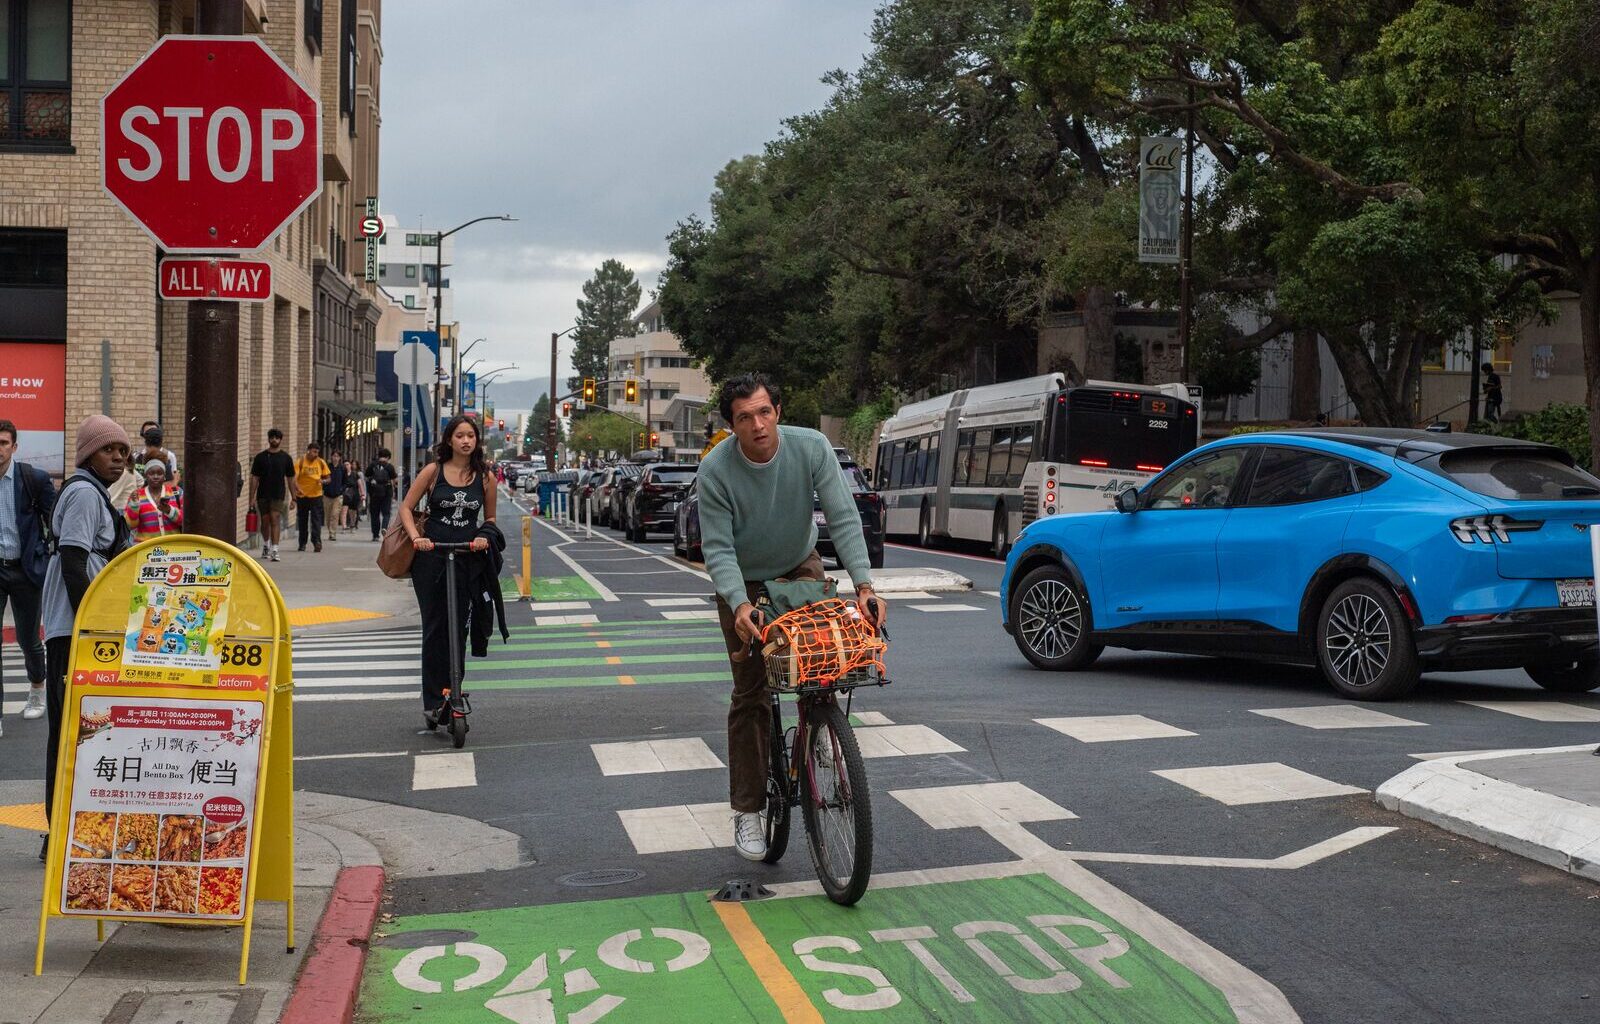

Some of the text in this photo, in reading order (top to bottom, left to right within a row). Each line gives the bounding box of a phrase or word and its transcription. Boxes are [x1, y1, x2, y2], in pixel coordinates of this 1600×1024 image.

[118, 105, 305, 183] STOP
[1145, 143, 1179, 168] Cal
[168, 267, 263, 293] ALL WAY
[1, 378, 44, 388] E NOW
[1151, 400, 1167, 413] 52
[1148, 419, 1169, 430] 2252
[221, 644, 262, 667] $88
[96, 674, 115, 683] No.1
[218, 676, 252, 687] latform
[144, 718, 167, 726] Sunday
[93, 755, 238, 787] 每日 便当
[165, 763, 180, 771] Day
[89, 788, 204, 801] 任意2菜$11.79 任意3菜$12.69
[792, 914, 1132, 1011] STOP
